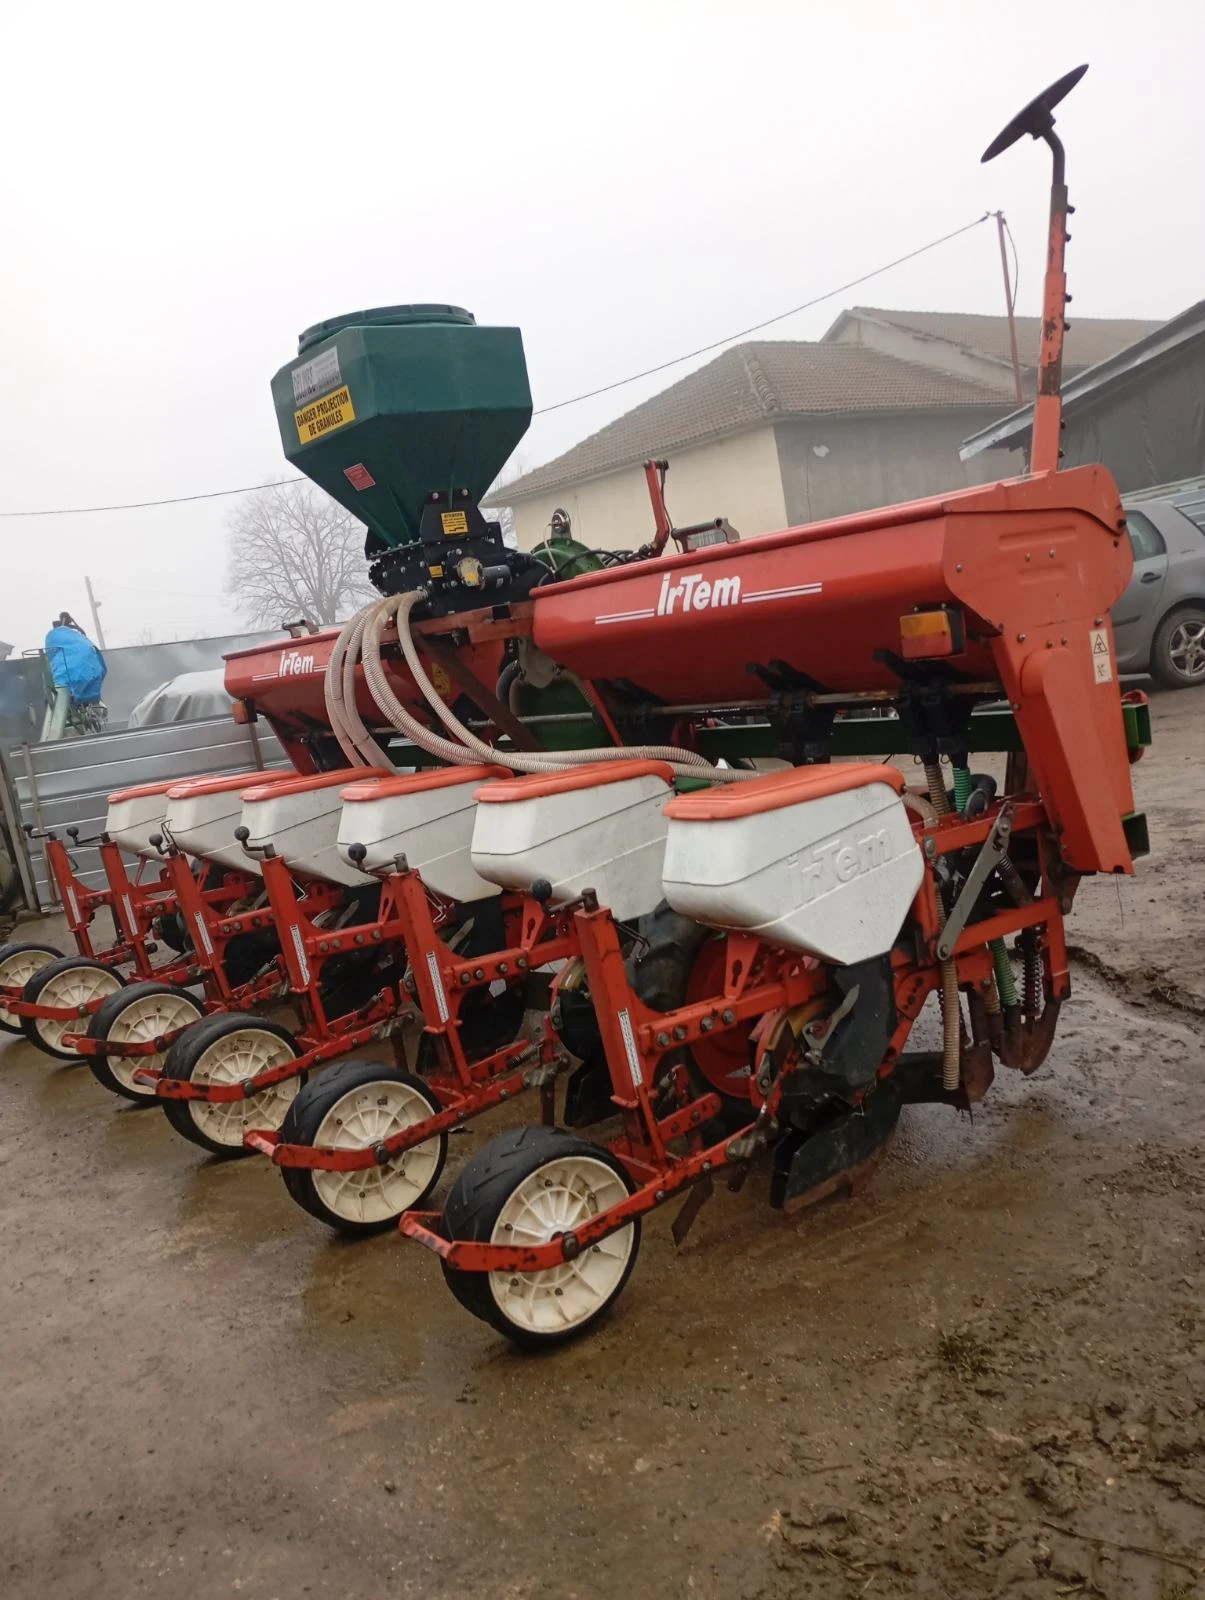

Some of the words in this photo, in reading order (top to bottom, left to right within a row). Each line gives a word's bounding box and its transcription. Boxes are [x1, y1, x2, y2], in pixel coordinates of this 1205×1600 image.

[296, 407, 318, 428] DANGER
[316, 390, 349, 417] PROJECTION
[308, 423, 317, 437] DE
